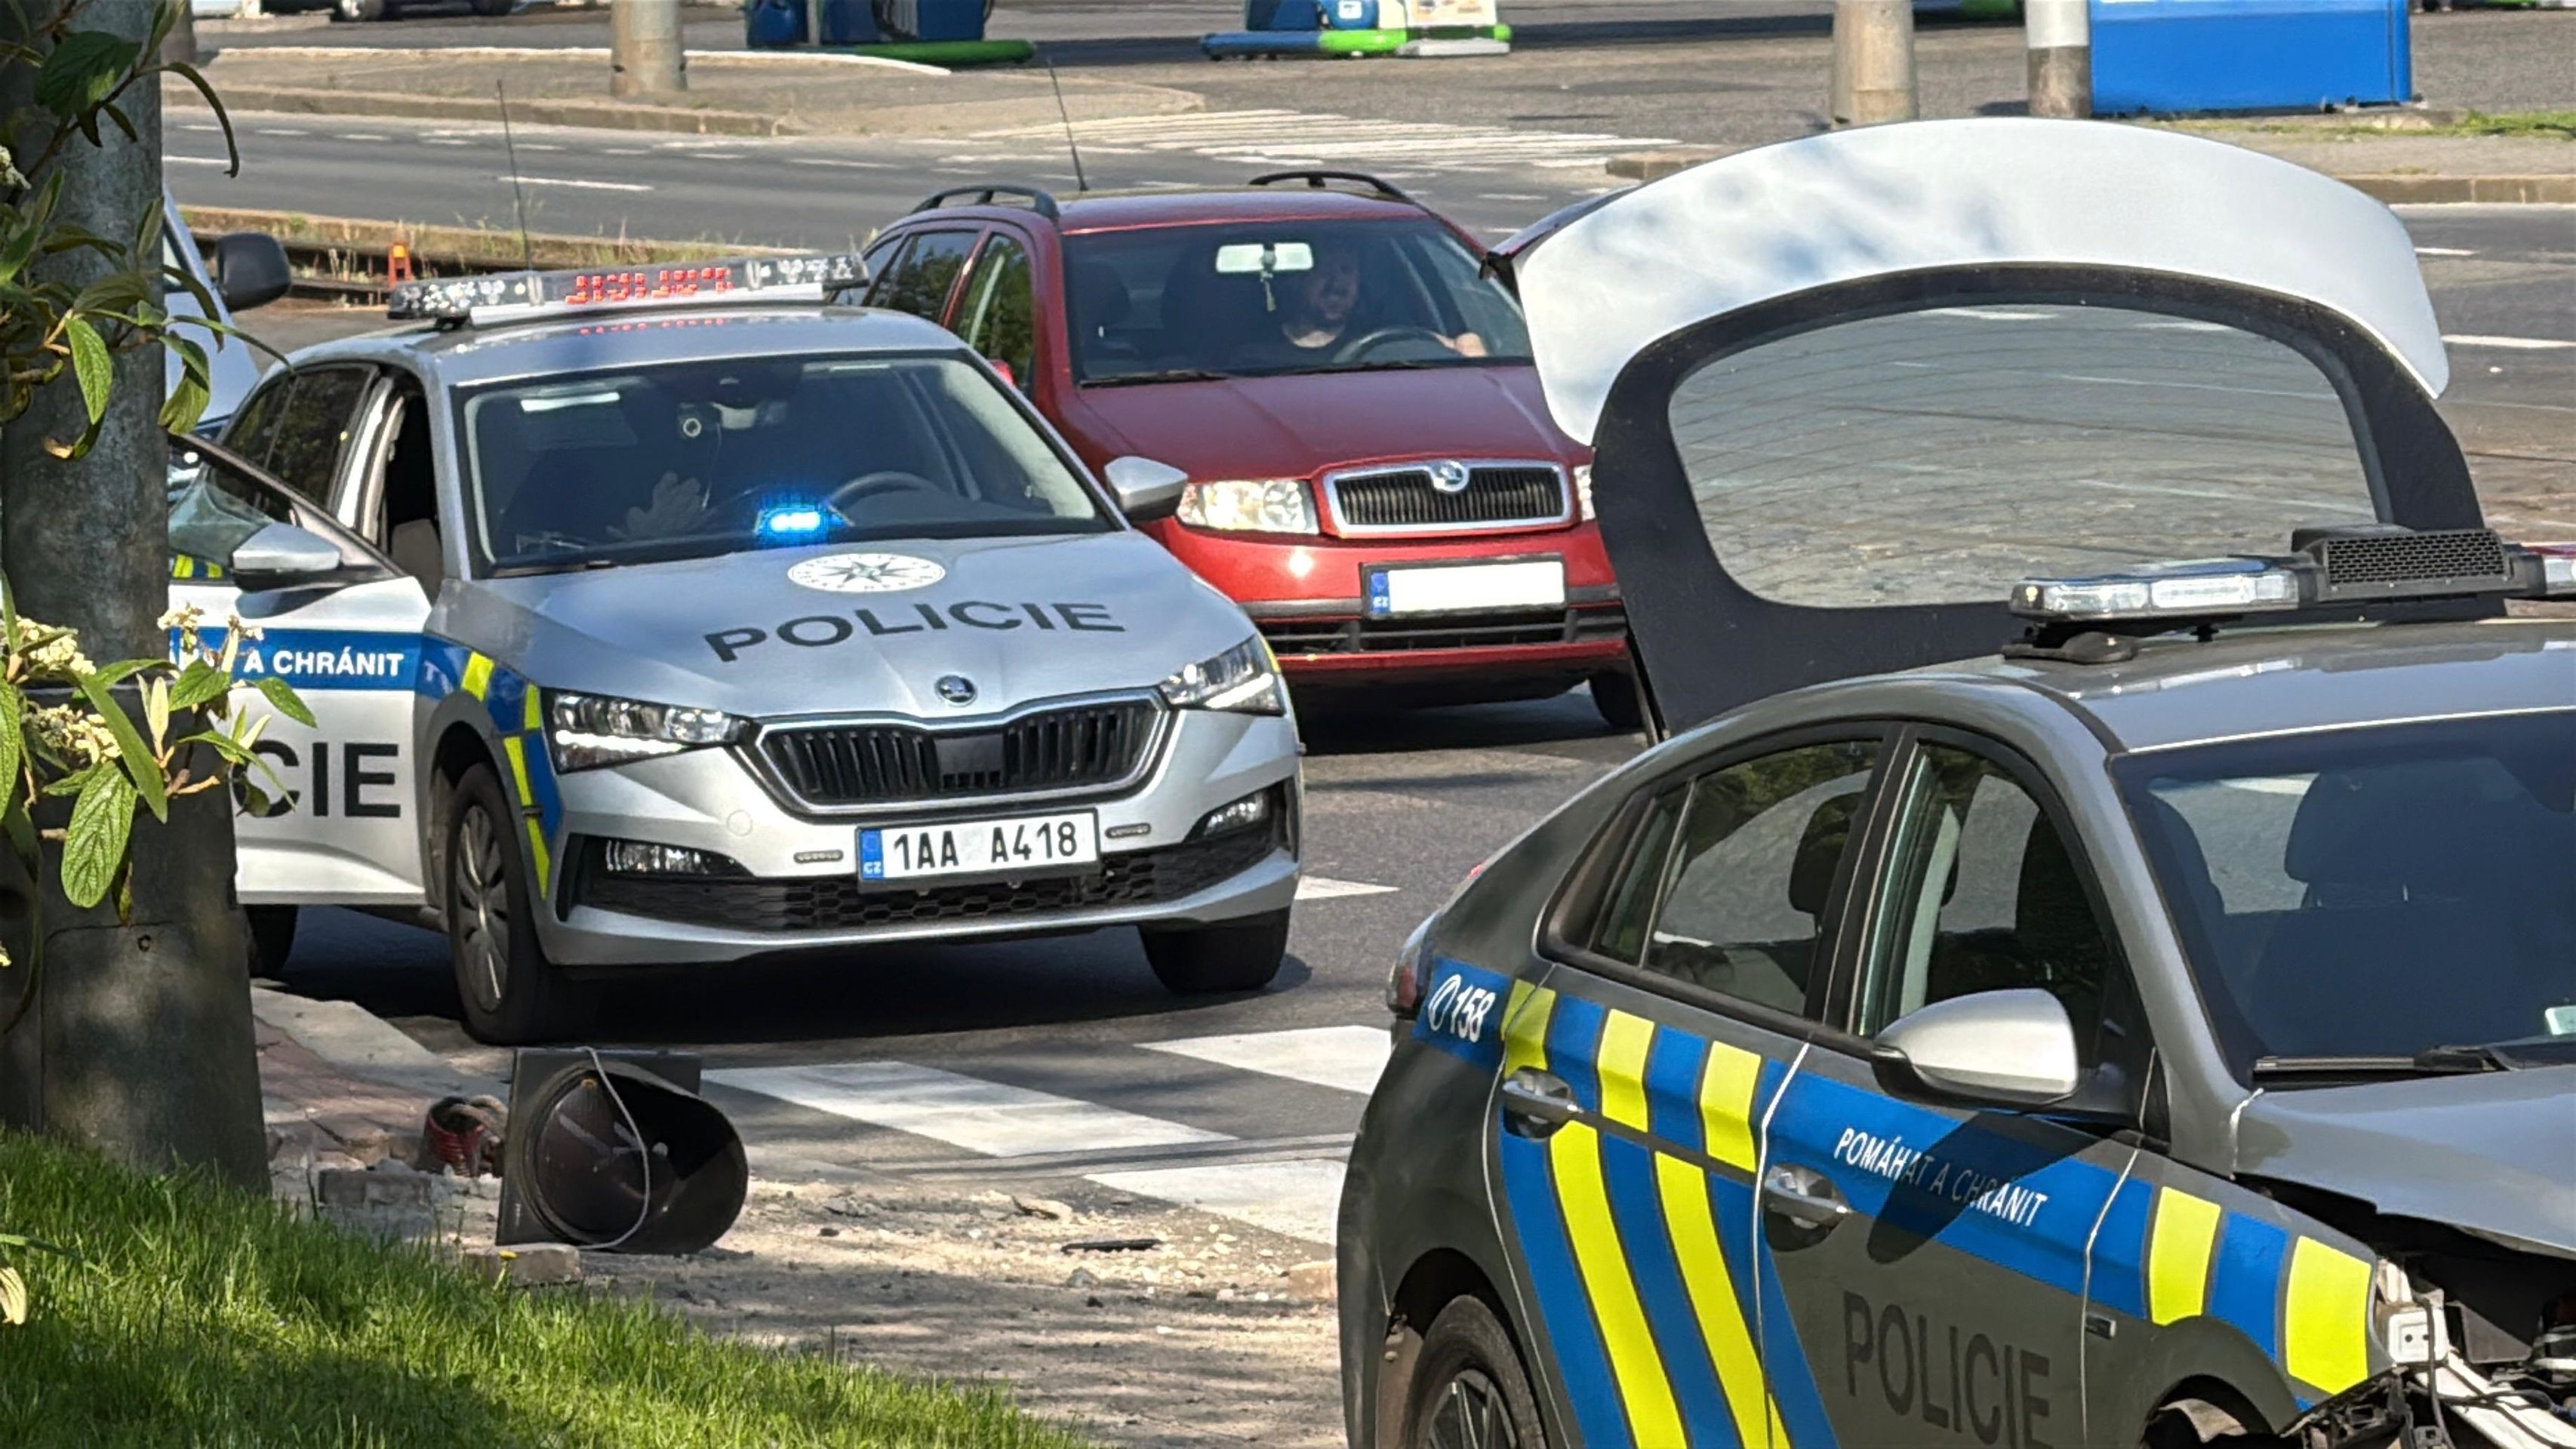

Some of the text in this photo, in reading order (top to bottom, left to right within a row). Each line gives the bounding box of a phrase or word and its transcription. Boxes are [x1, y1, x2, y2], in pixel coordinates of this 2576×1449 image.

[243, 649, 264, 673] A
[272, 645, 405, 676] CHRÁNIT
[703, 601, 1125, 662] POLICIE
[863, 820, 1077, 874] CZ 1AA A418
[1450, 984, 1496, 1043] 158
[1833, 1128, 1934, 1186] POMÁHAT
[1928, 1163, 1951, 1195] A
[1844, 1291, 2053, 1449] POLICIE
